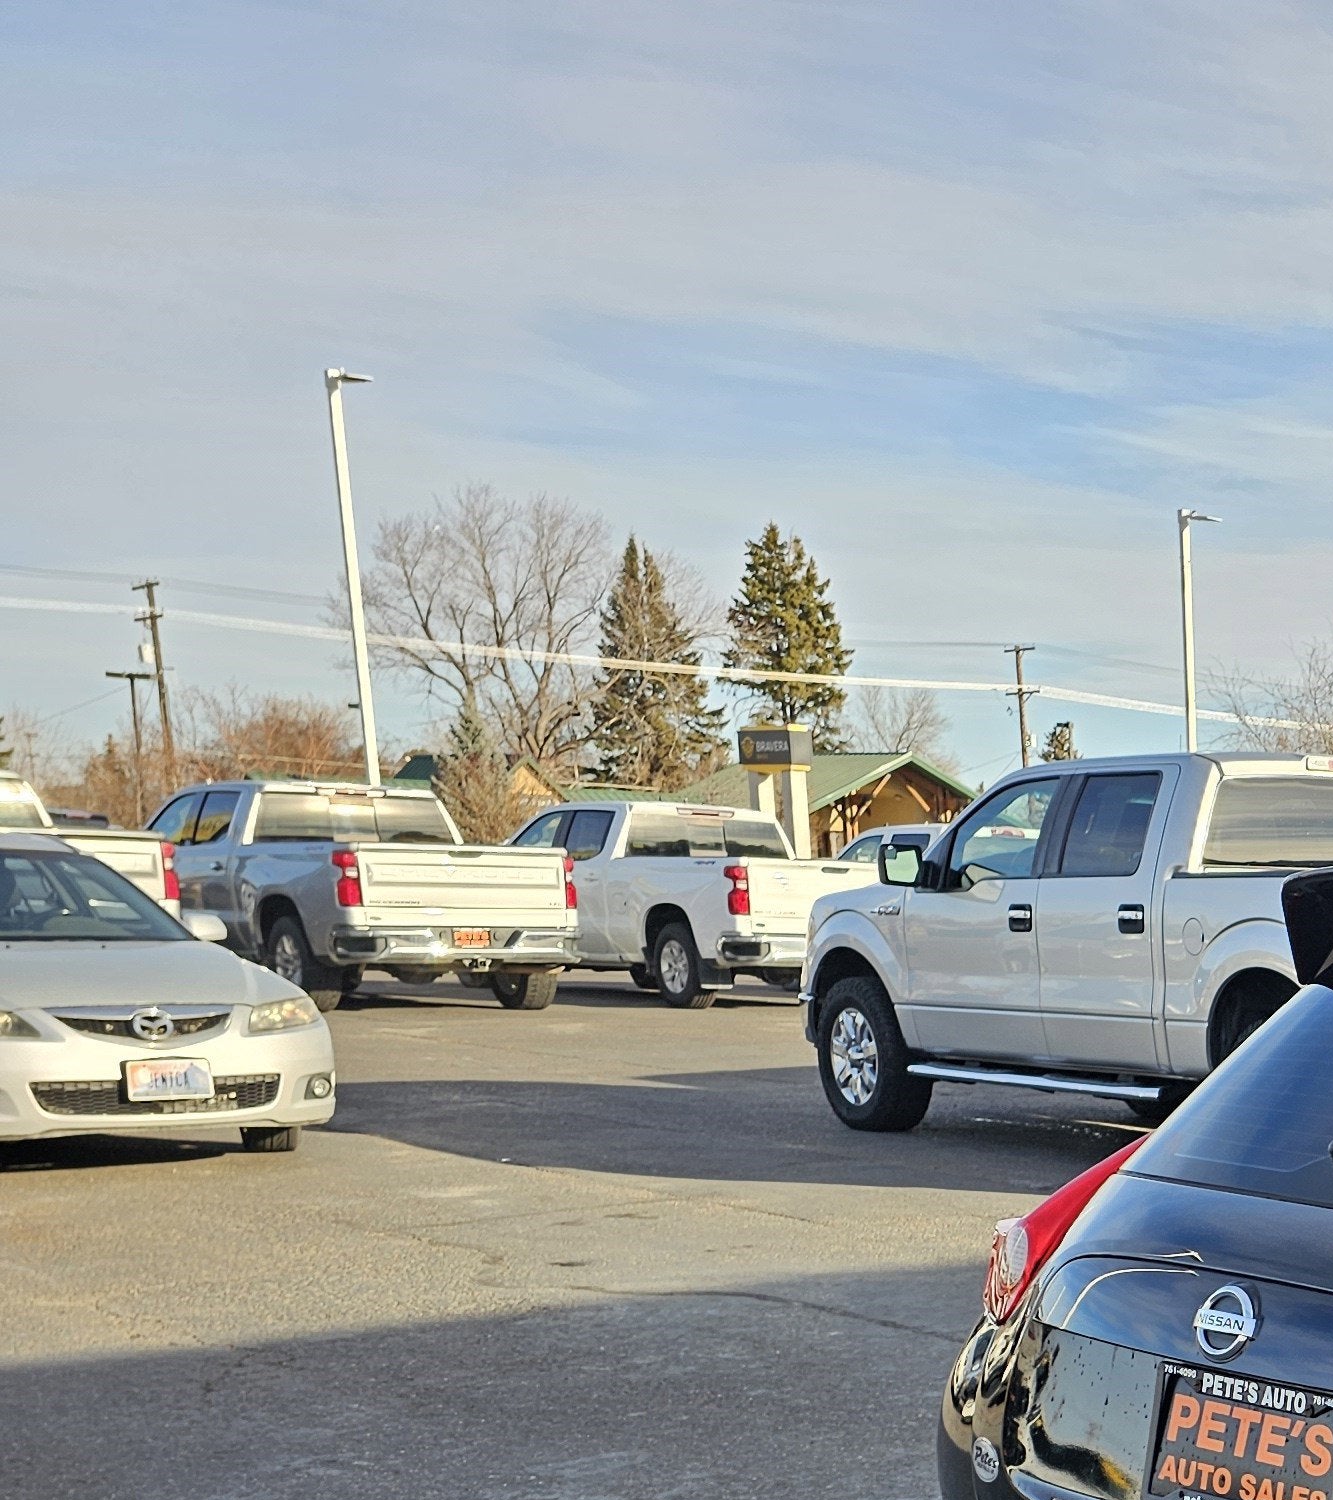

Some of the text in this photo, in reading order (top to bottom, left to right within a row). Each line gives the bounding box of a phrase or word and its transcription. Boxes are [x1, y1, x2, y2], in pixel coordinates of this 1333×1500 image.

[1197, 1312, 1246, 1332] NISSAN
[1163, 1363, 1198, 1380] 761-4090
[1200, 1372, 1307, 1415] PETE'S AUTO
[1157, 1454, 1233, 1496] AUTO
